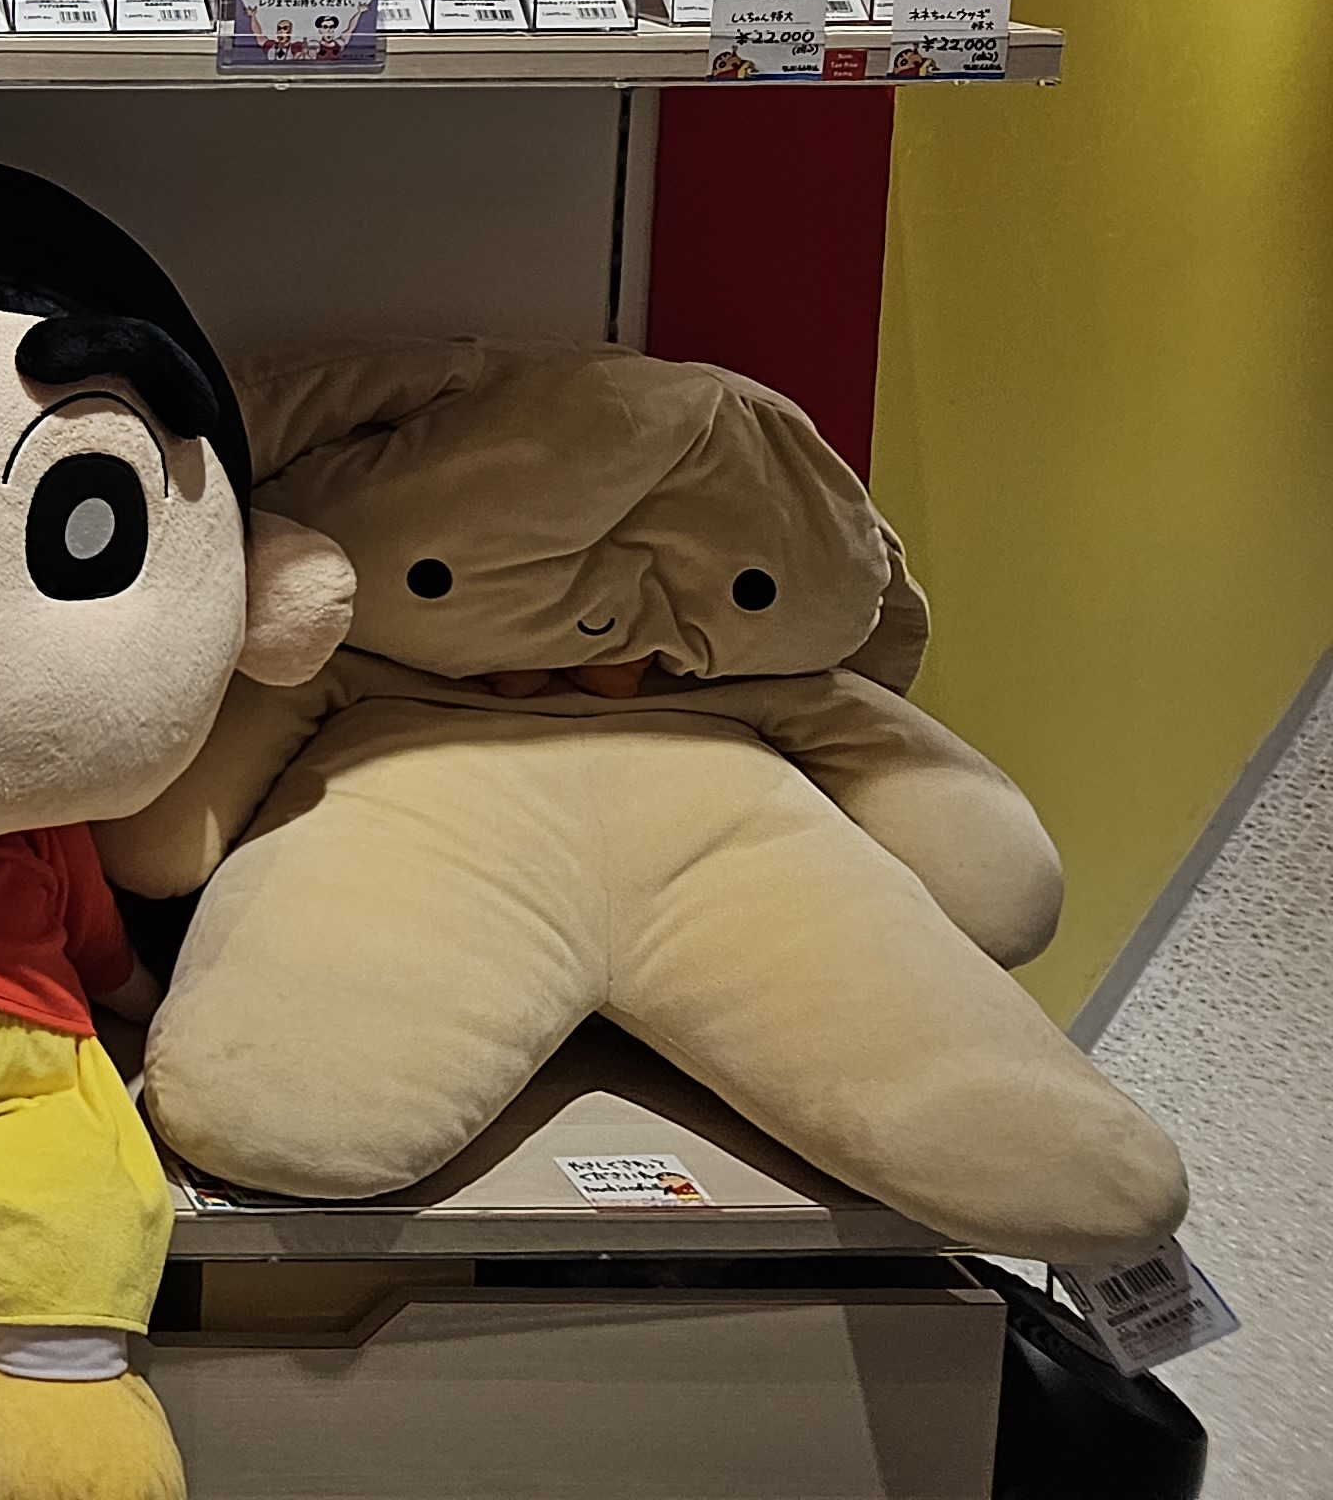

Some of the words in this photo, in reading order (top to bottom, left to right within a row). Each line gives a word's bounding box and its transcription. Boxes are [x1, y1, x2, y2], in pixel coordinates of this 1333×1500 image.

[908, 7, 991, 21] ネネちゃんウサギ
